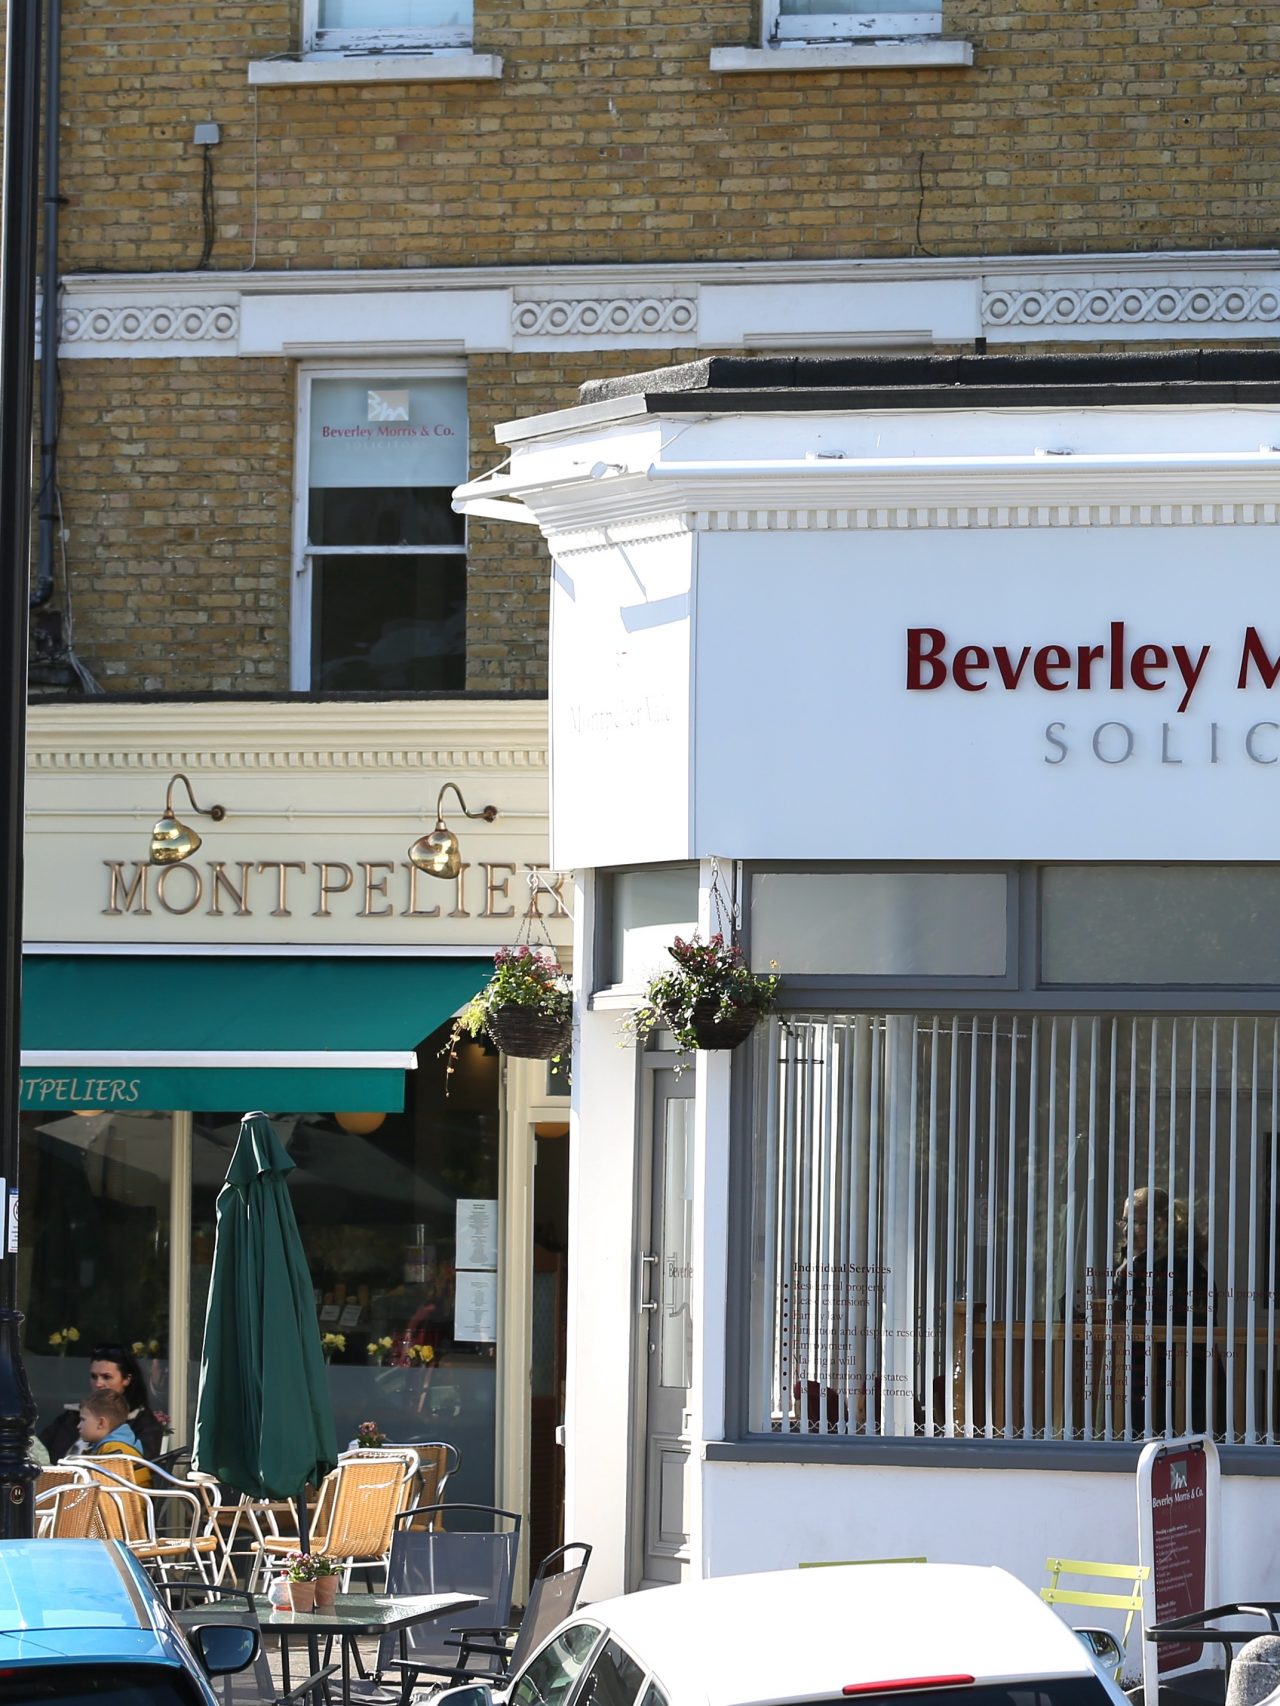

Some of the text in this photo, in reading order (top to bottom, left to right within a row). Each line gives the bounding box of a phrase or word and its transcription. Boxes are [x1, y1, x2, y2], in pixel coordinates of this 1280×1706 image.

[322, 423, 455, 440] Beverley Morris & Co.
[906, 621, 1211, 712] Beverley
[19, 1077, 141, 1102] TPELIERS
[793, 1262, 892, 1274] Individual Services
[793, 1294, 870, 1306] Leas etensions
[792, 1309, 826, 1323] Famy
[860, 1327, 894, 1340] dispte
[792, 1340, 852, 1353] Emoyment
[880, 1373, 909, 1382] states
[880, 1388, 915, 1400] ttorney
[1152, 1493, 1174, 1508] Beverley
[1174, 1489, 1191, 1503] Morris
